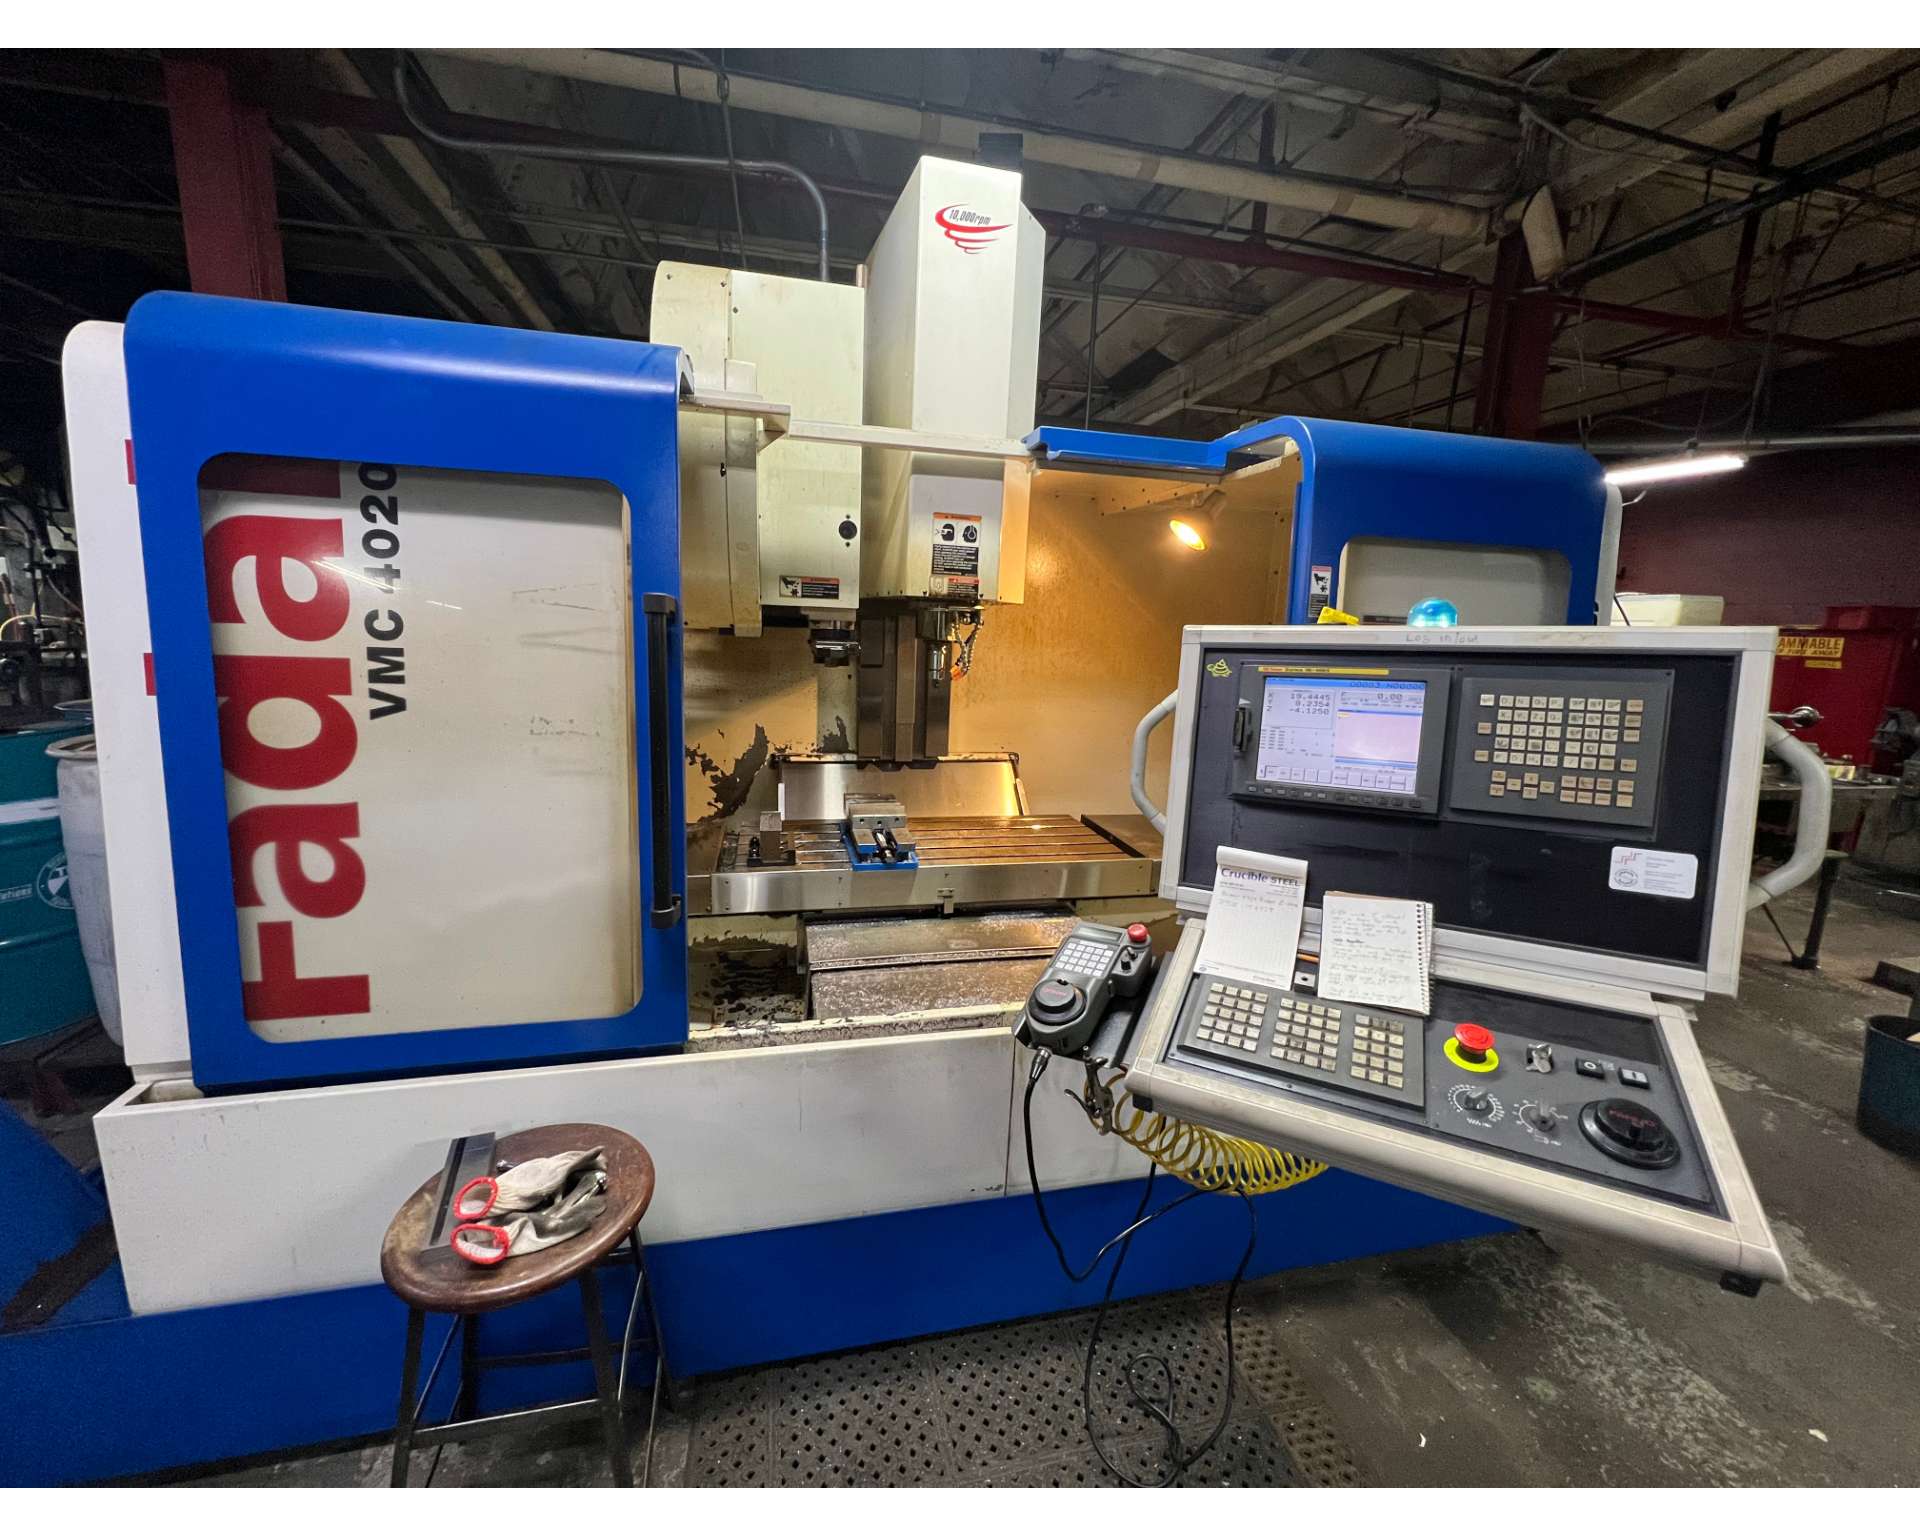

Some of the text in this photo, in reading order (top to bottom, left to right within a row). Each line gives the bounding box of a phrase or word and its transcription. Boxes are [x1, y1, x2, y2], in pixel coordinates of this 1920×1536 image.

[358, 463, 406, 720] VMC 4020
[1221, 867, 1268, 883] Crucible
